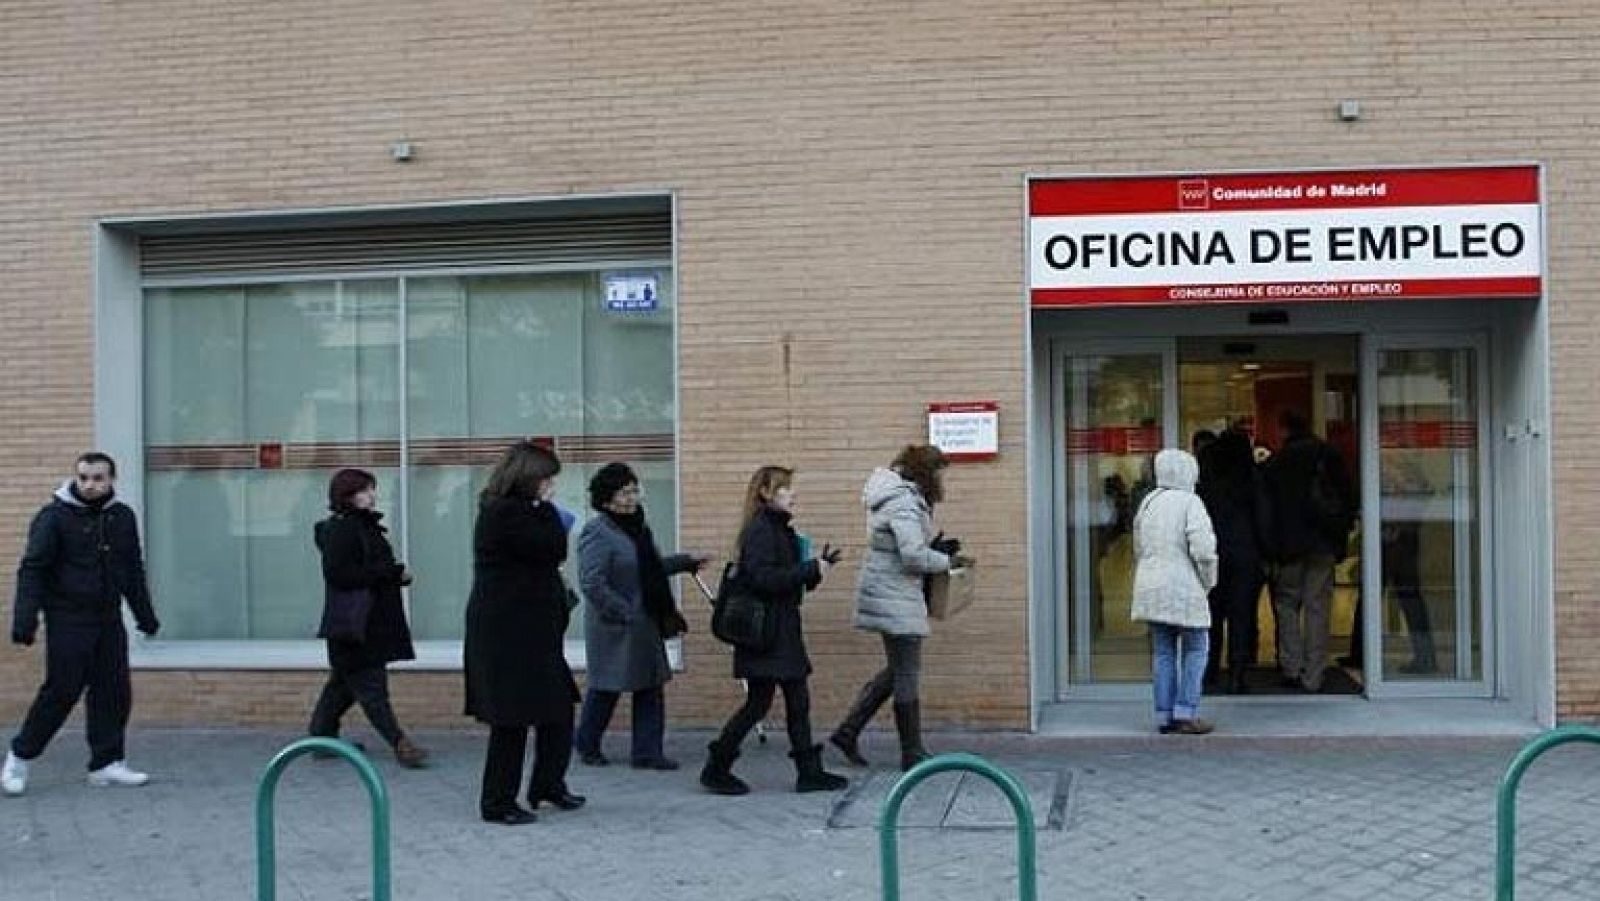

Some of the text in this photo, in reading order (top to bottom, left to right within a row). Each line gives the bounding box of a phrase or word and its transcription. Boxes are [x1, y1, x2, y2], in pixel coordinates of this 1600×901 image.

[1211, 182, 1387, 200] Comunidad de Madrid
[1044, 222, 1525, 270] OFICINA DE EMPLEO
[1248, 285, 1266, 297] DE
[1341, 283, 1350, 295] Y
[1351, 282, 1402, 295] EMPLEO
